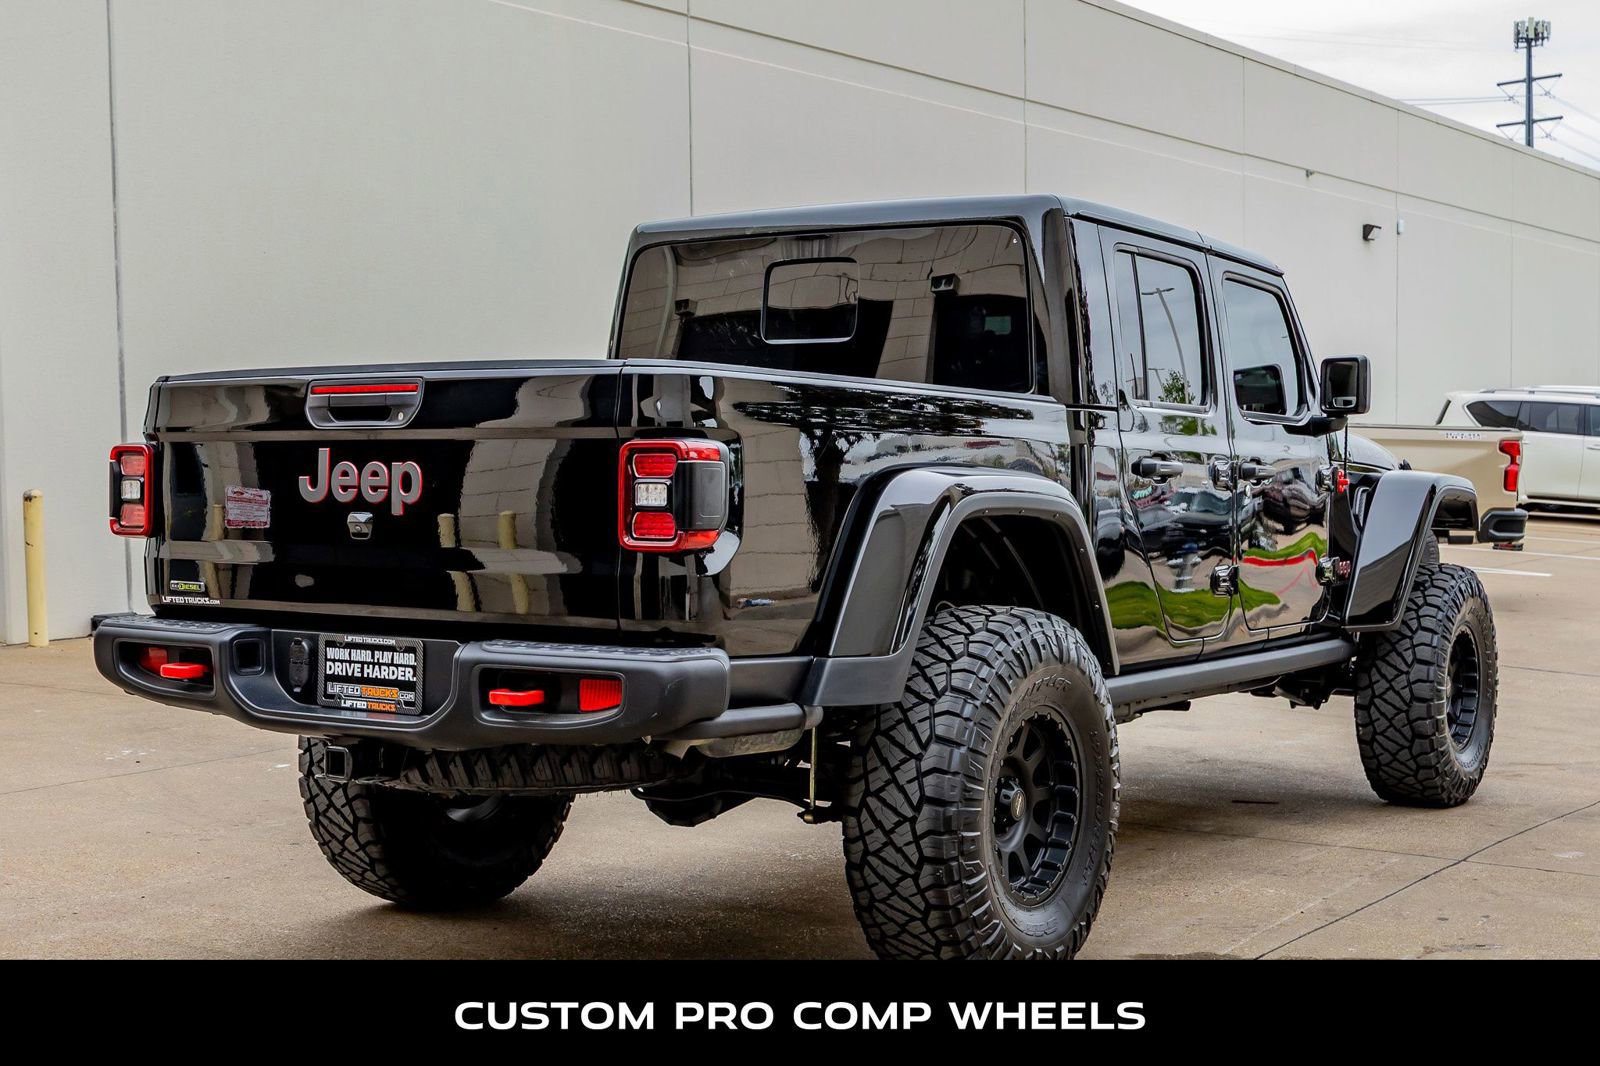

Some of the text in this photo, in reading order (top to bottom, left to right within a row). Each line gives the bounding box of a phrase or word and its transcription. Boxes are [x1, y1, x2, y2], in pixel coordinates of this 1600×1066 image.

[298, 447, 423, 516] Jeep
[326, 647, 416, 665] WORK HARD. PLAY HARD.
[326, 661, 416, 681] DRIVE HARDER.
